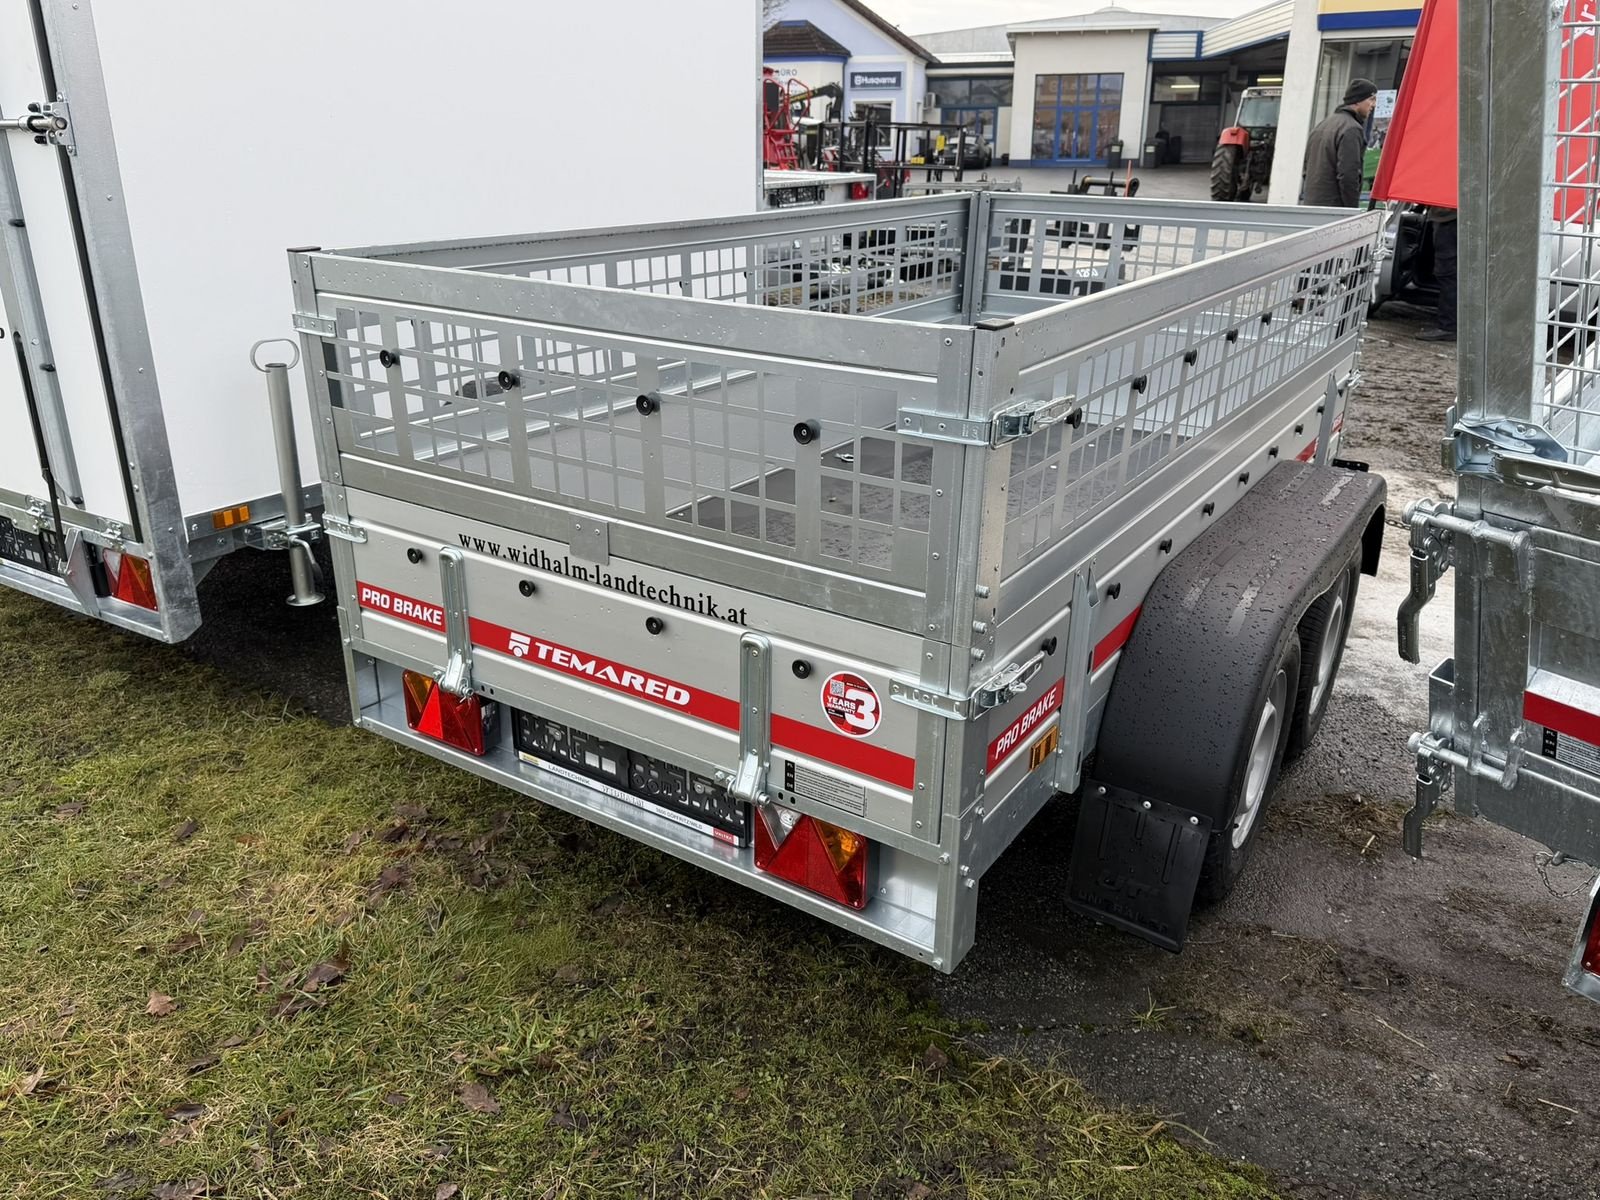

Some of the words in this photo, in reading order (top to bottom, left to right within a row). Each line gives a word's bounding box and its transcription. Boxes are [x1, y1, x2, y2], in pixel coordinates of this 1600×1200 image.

[861, 75, 897, 85] Husqvarna
[458, 533, 748, 627] www.widhalm-landtechnik.at
[361, 587, 391, 610] PRO
[393, 597, 444, 626] BRAKE
[535, 641, 691, 706] TEMARED
[827, 694, 857, 711] YEARS
[845, 688, 876, 731] 3
[995, 723, 1020, 760] PRO
[1020, 687, 1057, 736] BRAKE
[548, 764, 591, 785] LANDTECHNIK
